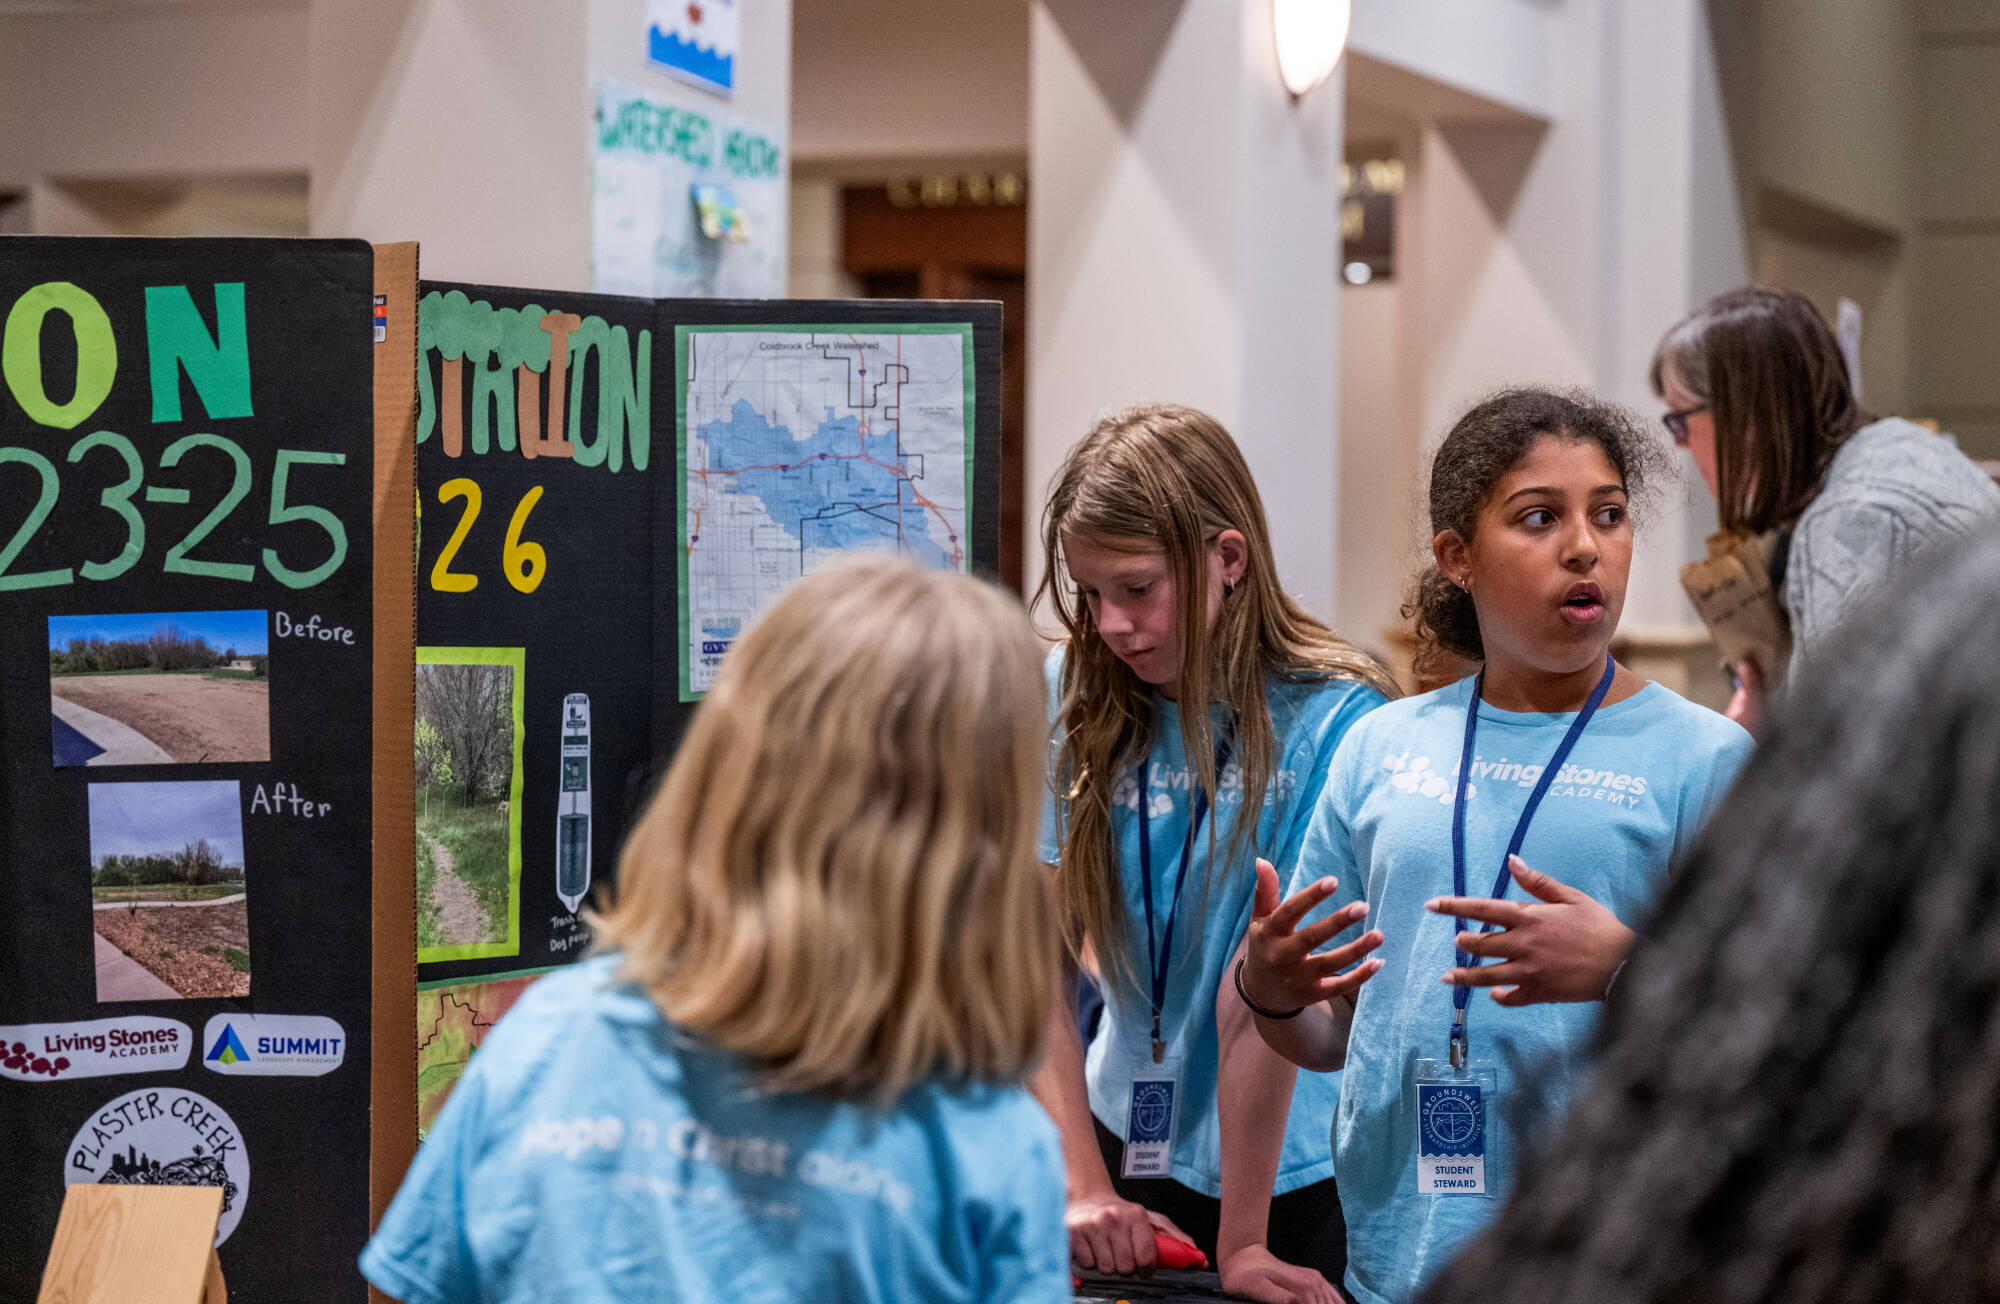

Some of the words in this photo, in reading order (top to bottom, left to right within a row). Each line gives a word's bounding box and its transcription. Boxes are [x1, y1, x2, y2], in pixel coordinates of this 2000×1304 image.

[759, 341, 802, 350] Coldbrook
[805, 341, 832, 350] Creek
[833, 341, 879, 350] Watershed
[275, 611, 355, 645] Before
[251, 782, 331, 818] After
[1549, 785, 1640, 809] CADEMY
[551, 914, 575, 929] Trash
[550, 938, 567, 951] Dog
[44, 1034, 106, 1054] Living
[108, 1028, 179, 1047] Stones
[257, 1037, 342, 1055] SUMMIT
[108, 1043, 180, 1059] ACADEMY
[72, 1092, 165, 1174] PLASTER
[171, 1096, 237, 1162] CREEK
[1435, 1165, 1474, 1175] STUDENT
[1433, 1179, 1477, 1188] STEWARD
